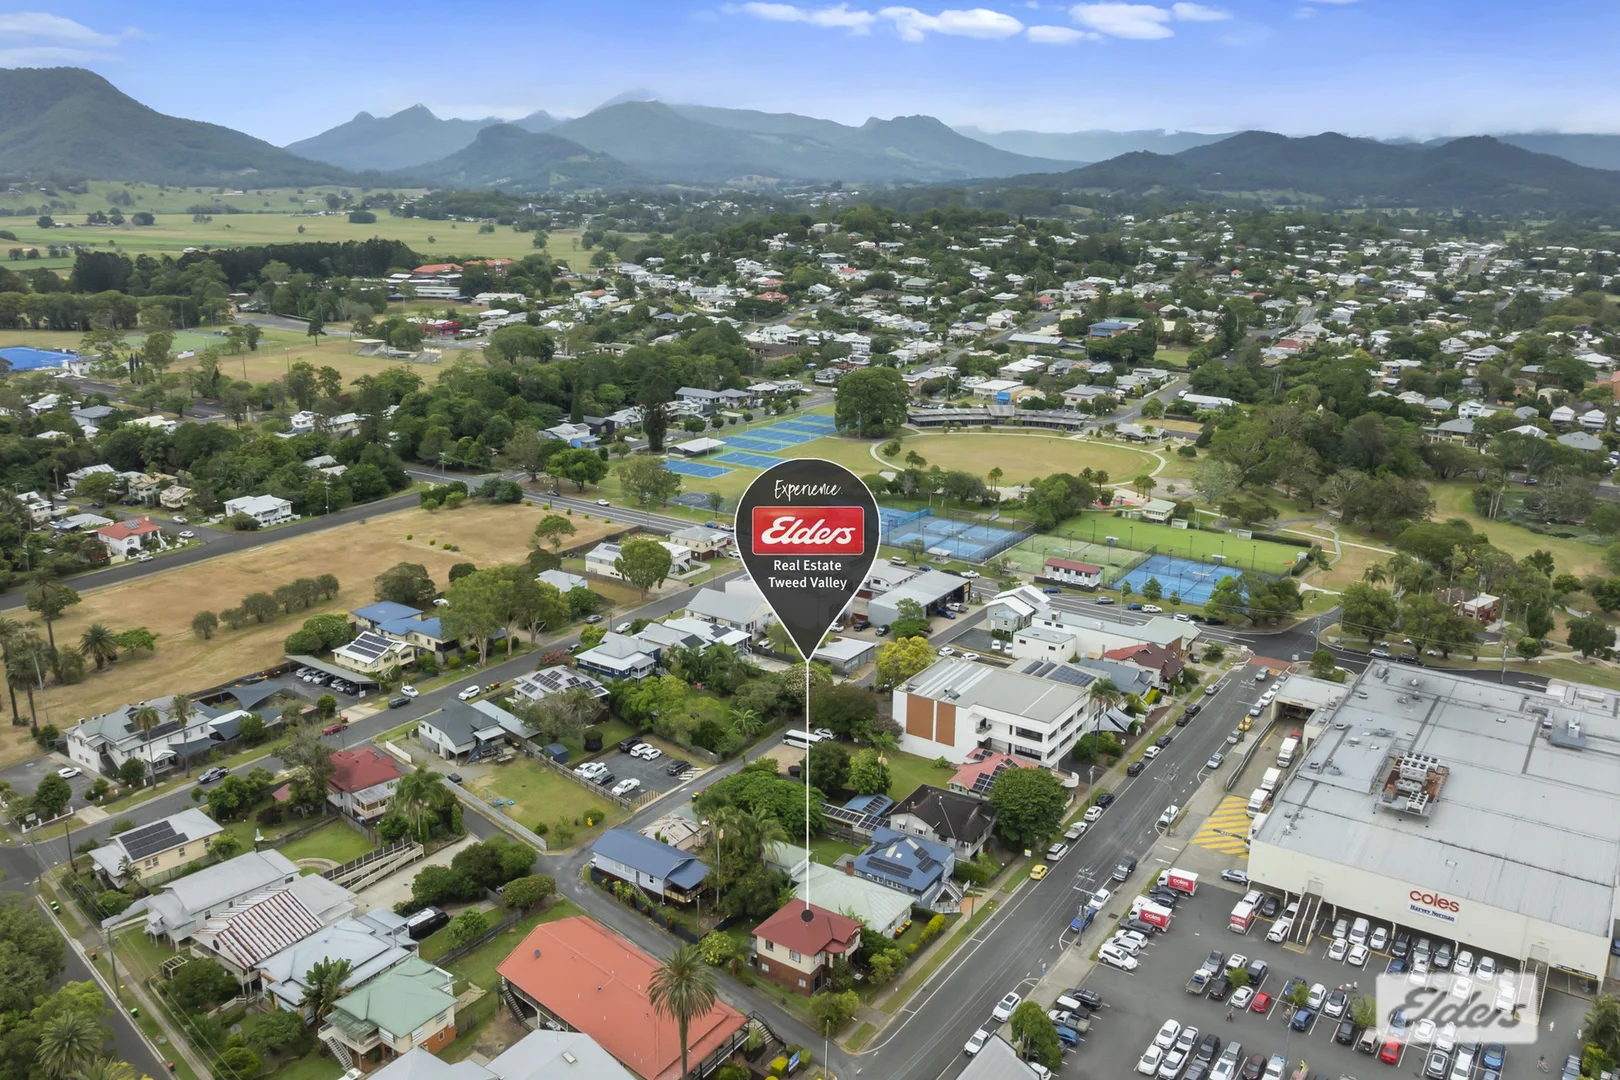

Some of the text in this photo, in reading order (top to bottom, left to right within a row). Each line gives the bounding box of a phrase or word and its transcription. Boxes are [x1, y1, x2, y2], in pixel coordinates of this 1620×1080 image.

[1409, 890, 1460, 913] coles
[1410, 904, 1455, 922] Harvey Norman
